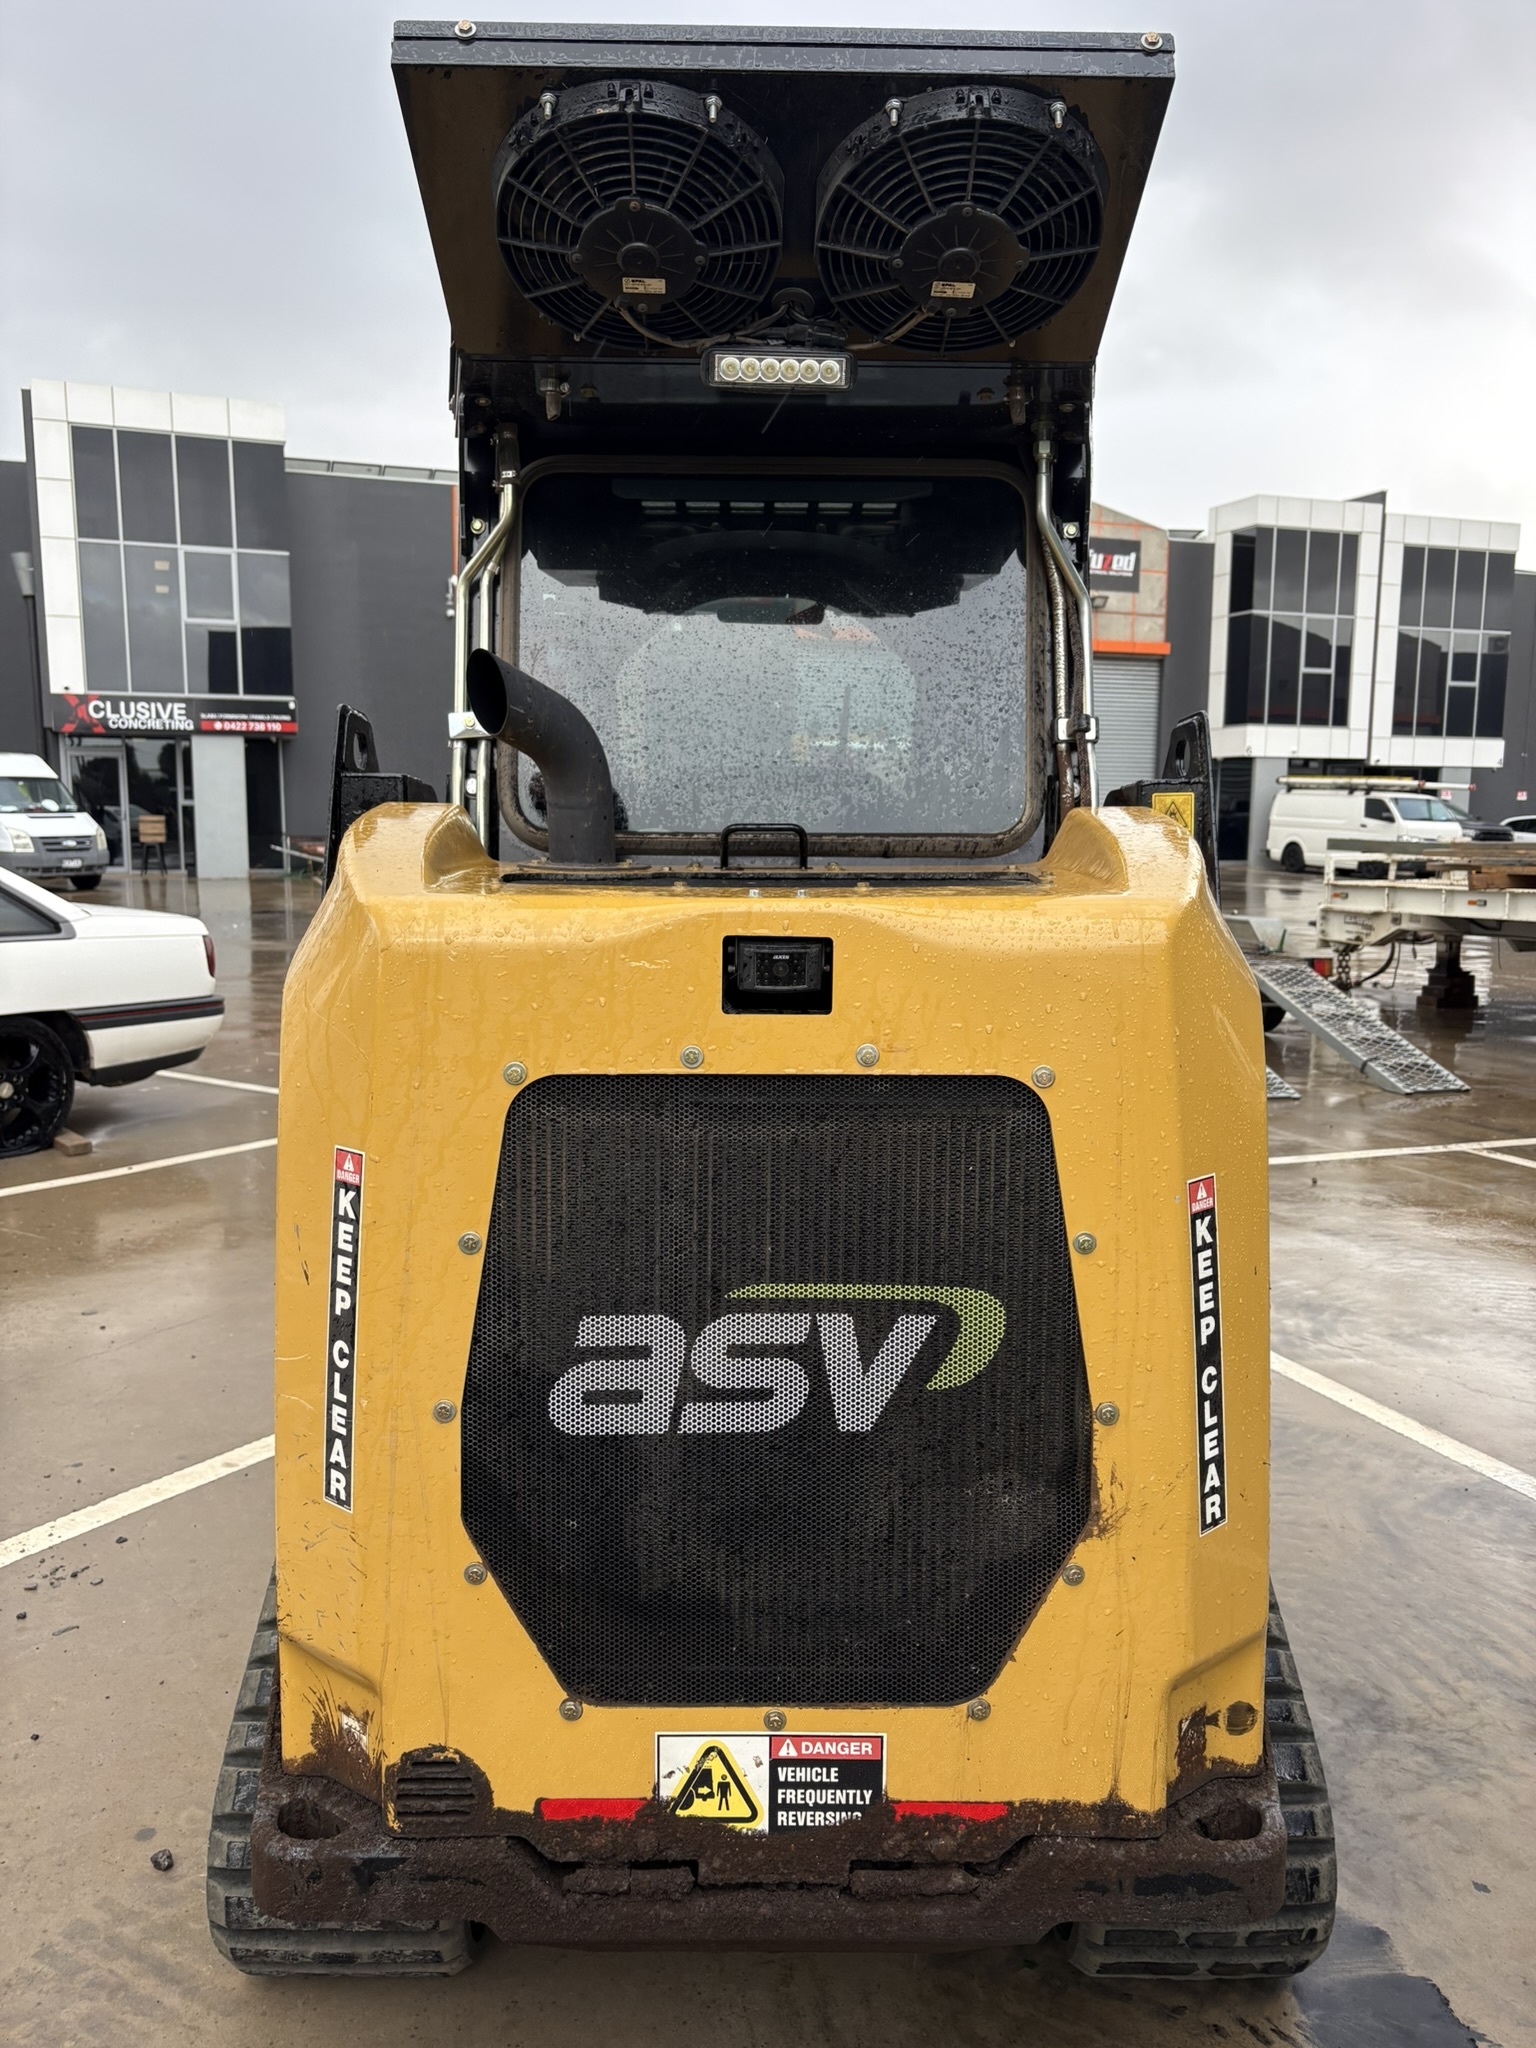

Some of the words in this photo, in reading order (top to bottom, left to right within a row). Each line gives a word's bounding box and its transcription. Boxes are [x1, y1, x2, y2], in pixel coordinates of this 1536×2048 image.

[108, 719, 194, 731] CONCRETING
[223, 721, 247, 731] 0422
[336, 1168, 360, 1184] DANGER
[1191, 1196, 1214, 1213] DANGER
[335, 1188, 357, 1317] KEEP
[1195, 1215, 1216, 1347] KEEP
[329, 1339, 350, 1502] CLEAR
[1201, 1365, 1222, 1525] CLEAR
[801, 1742, 873, 1755] DANGER
[777, 1766, 839, 1783] VEHICLE
[777, 1789, 873, 1807] FREQUENTLY
